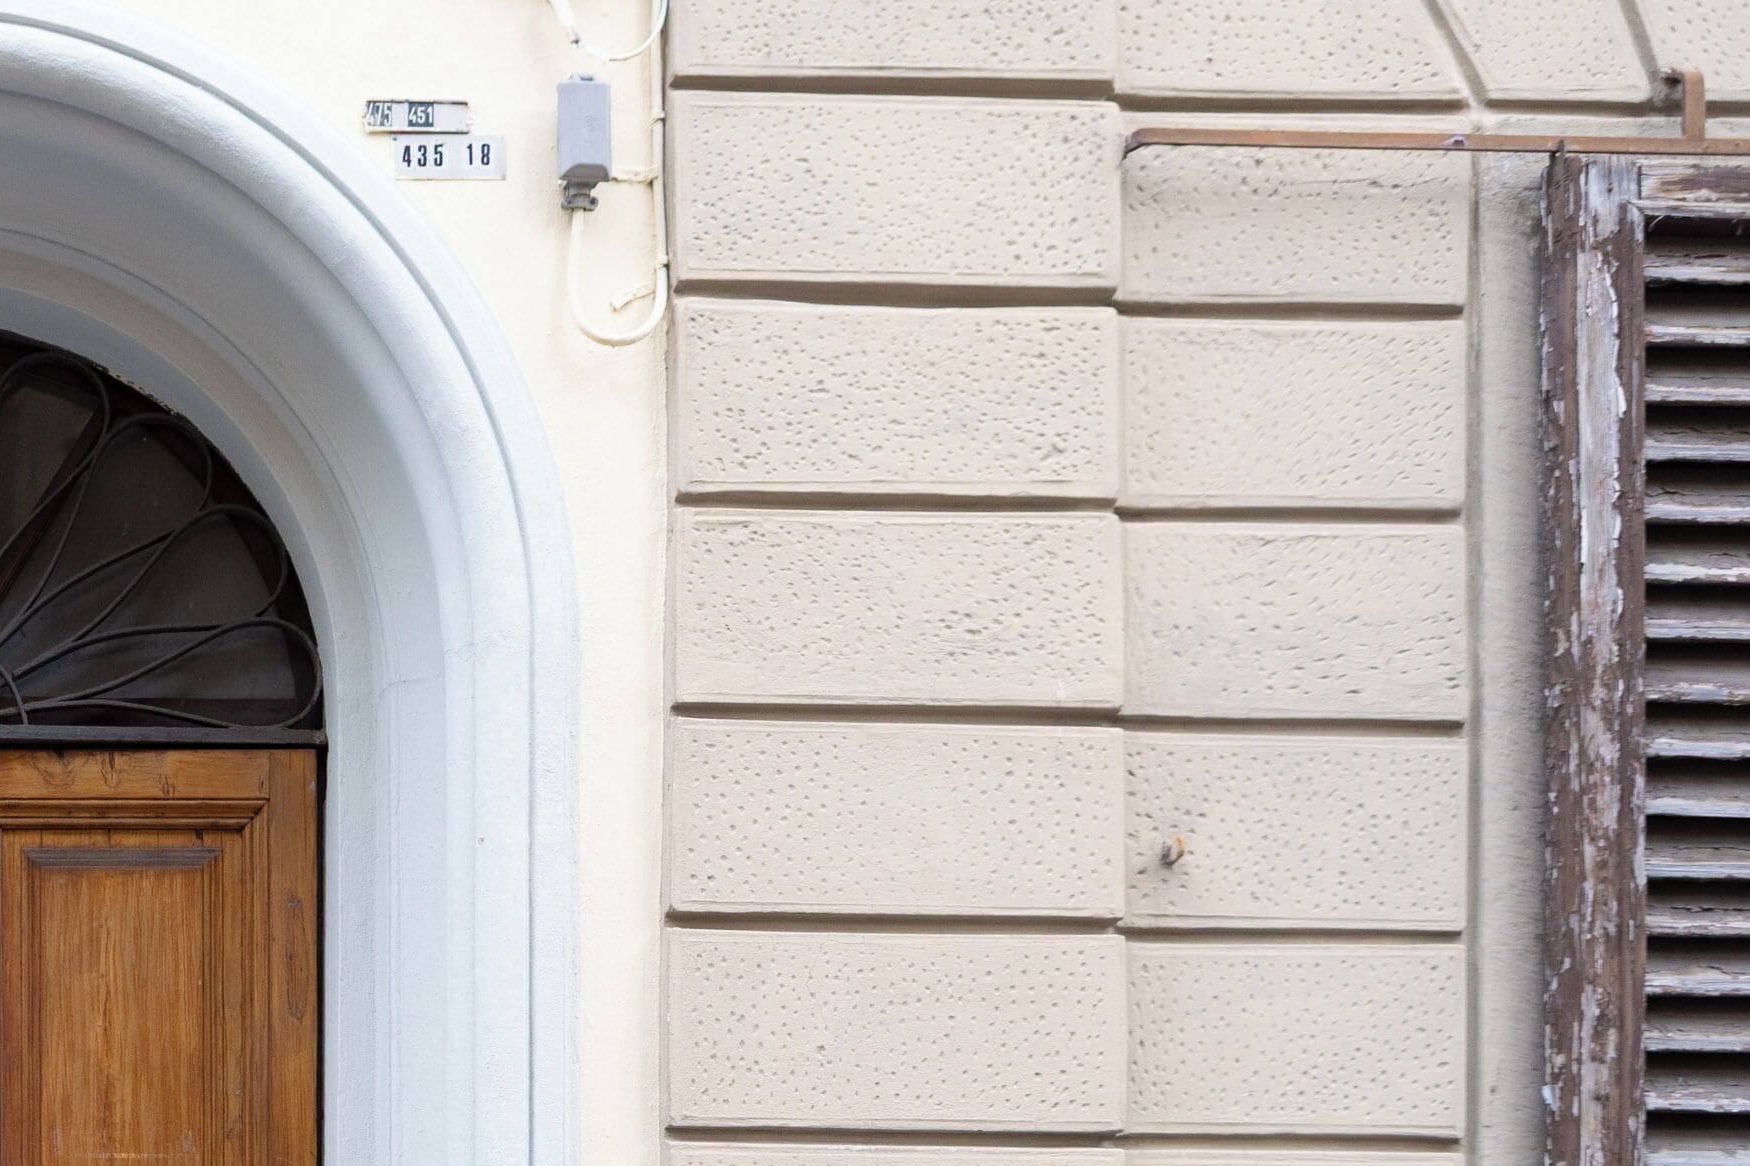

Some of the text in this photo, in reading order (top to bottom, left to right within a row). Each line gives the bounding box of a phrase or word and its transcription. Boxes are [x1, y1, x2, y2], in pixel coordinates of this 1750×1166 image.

[408, 106, 433, 124] 451
[402, 143, 491, 167] 435 18
